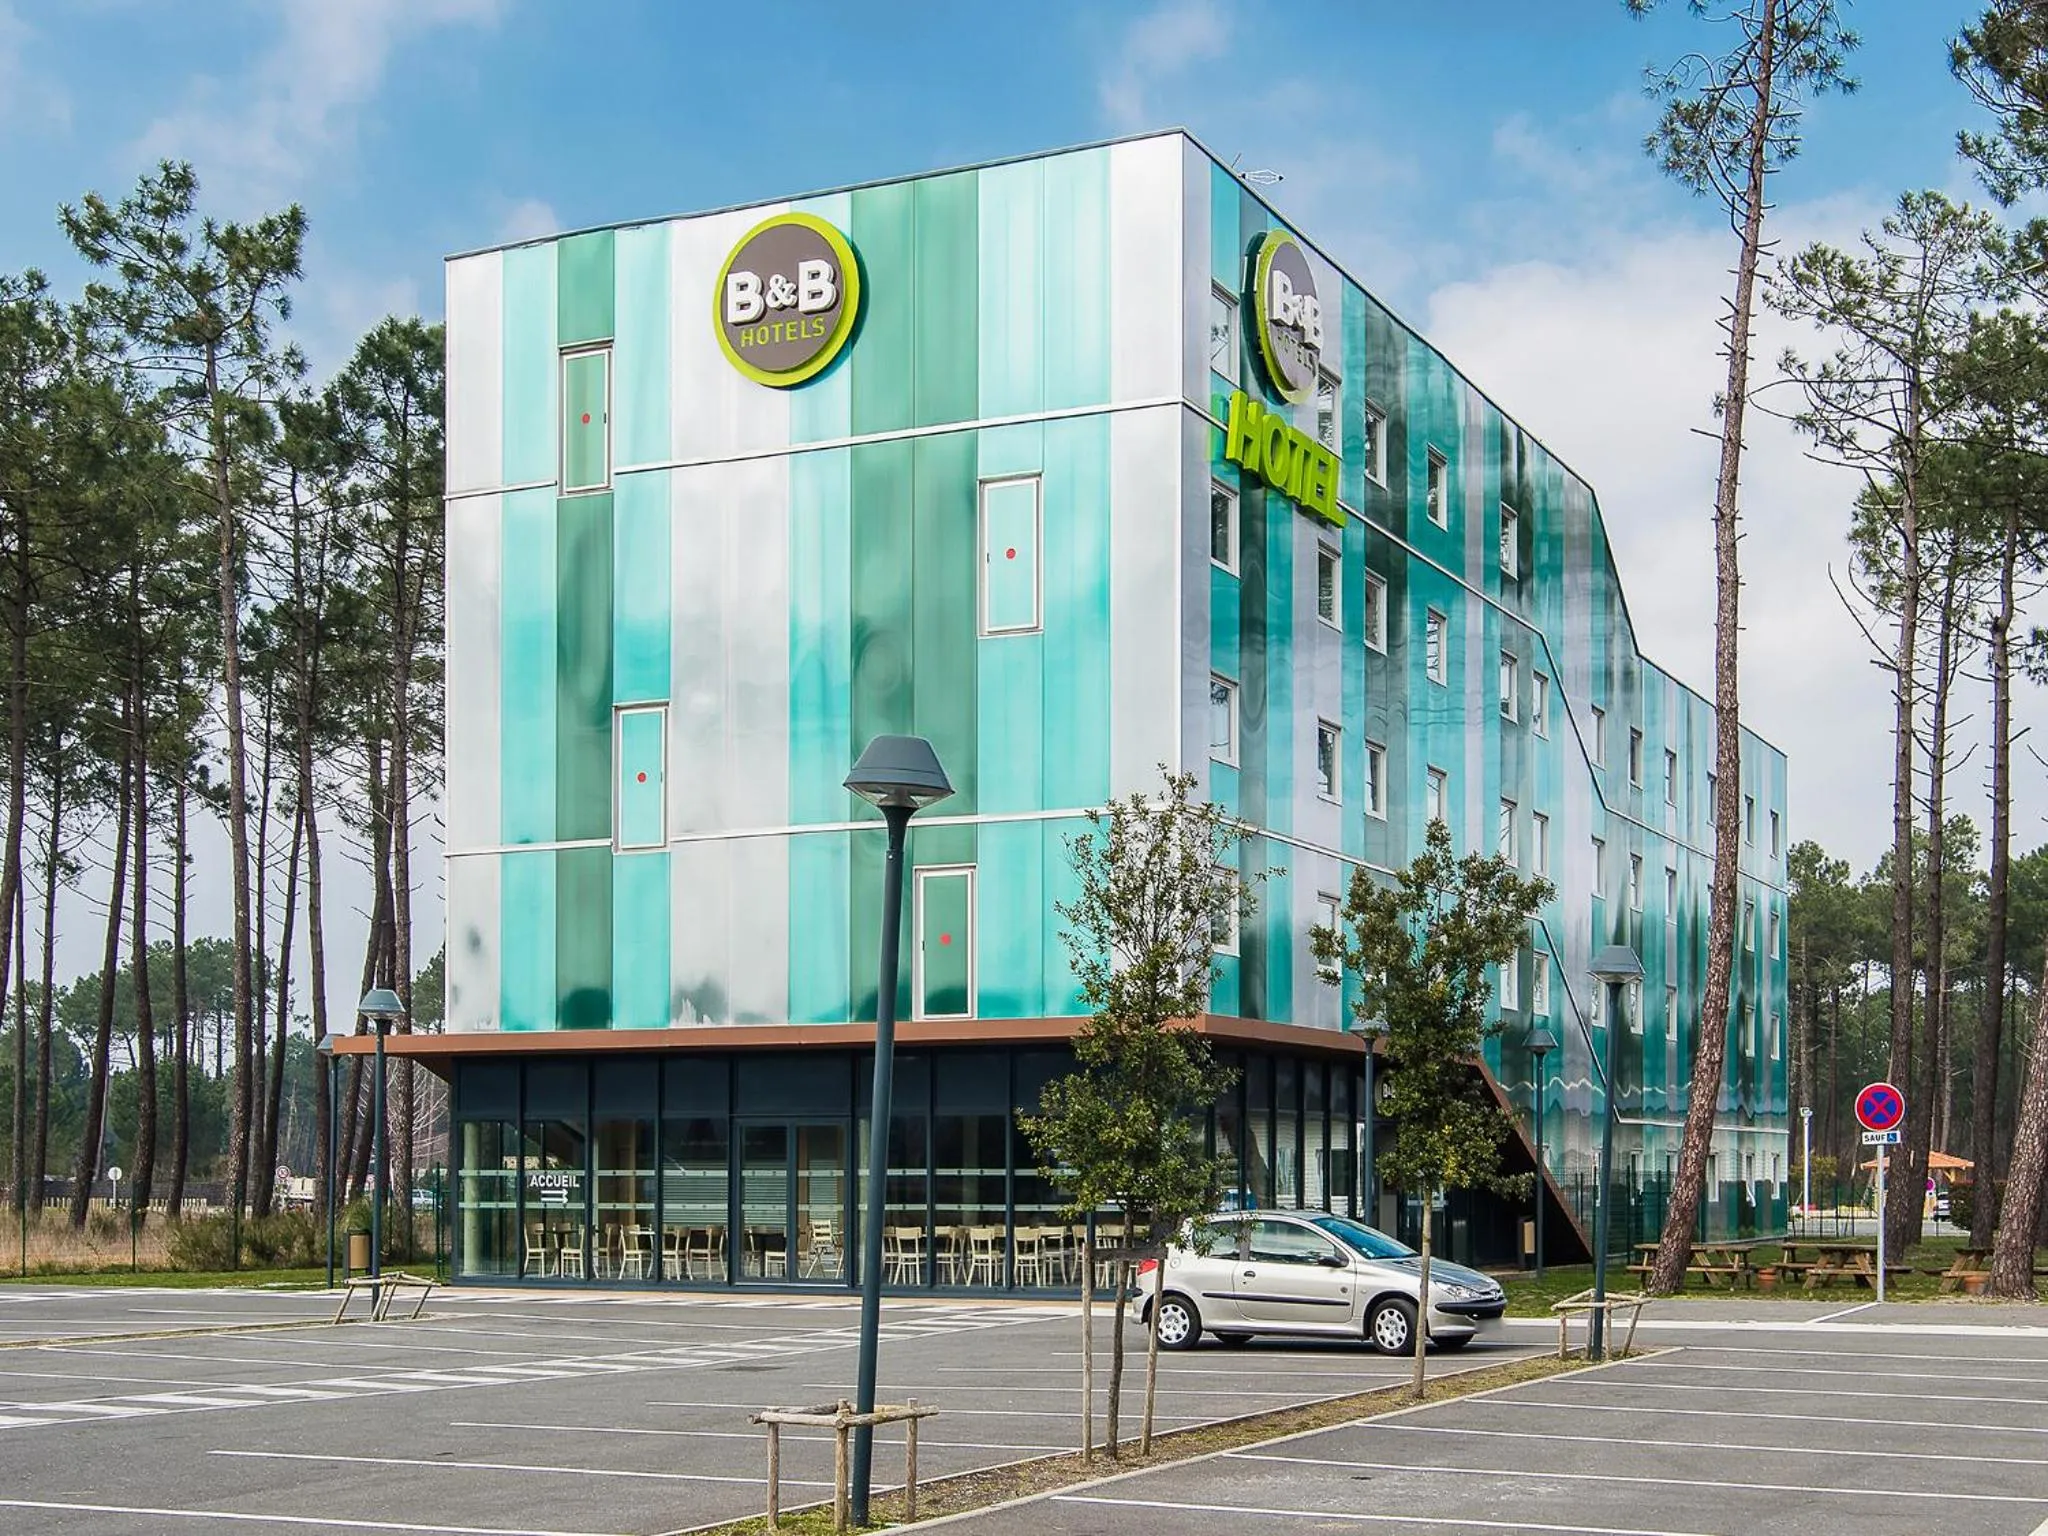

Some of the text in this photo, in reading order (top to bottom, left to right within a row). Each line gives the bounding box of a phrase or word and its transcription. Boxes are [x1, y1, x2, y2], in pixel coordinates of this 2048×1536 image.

[727, 259, 837, 324] B&B
[1270, 270, 1322, 350] B&B
[741, 317, 826, 347] HOTELS
[1226, 389, 1347, 528] HOTEL
[1864, 1134, 1887, 1142] SAUF
[529, 1175, 580, 1188] ACCUEIL
